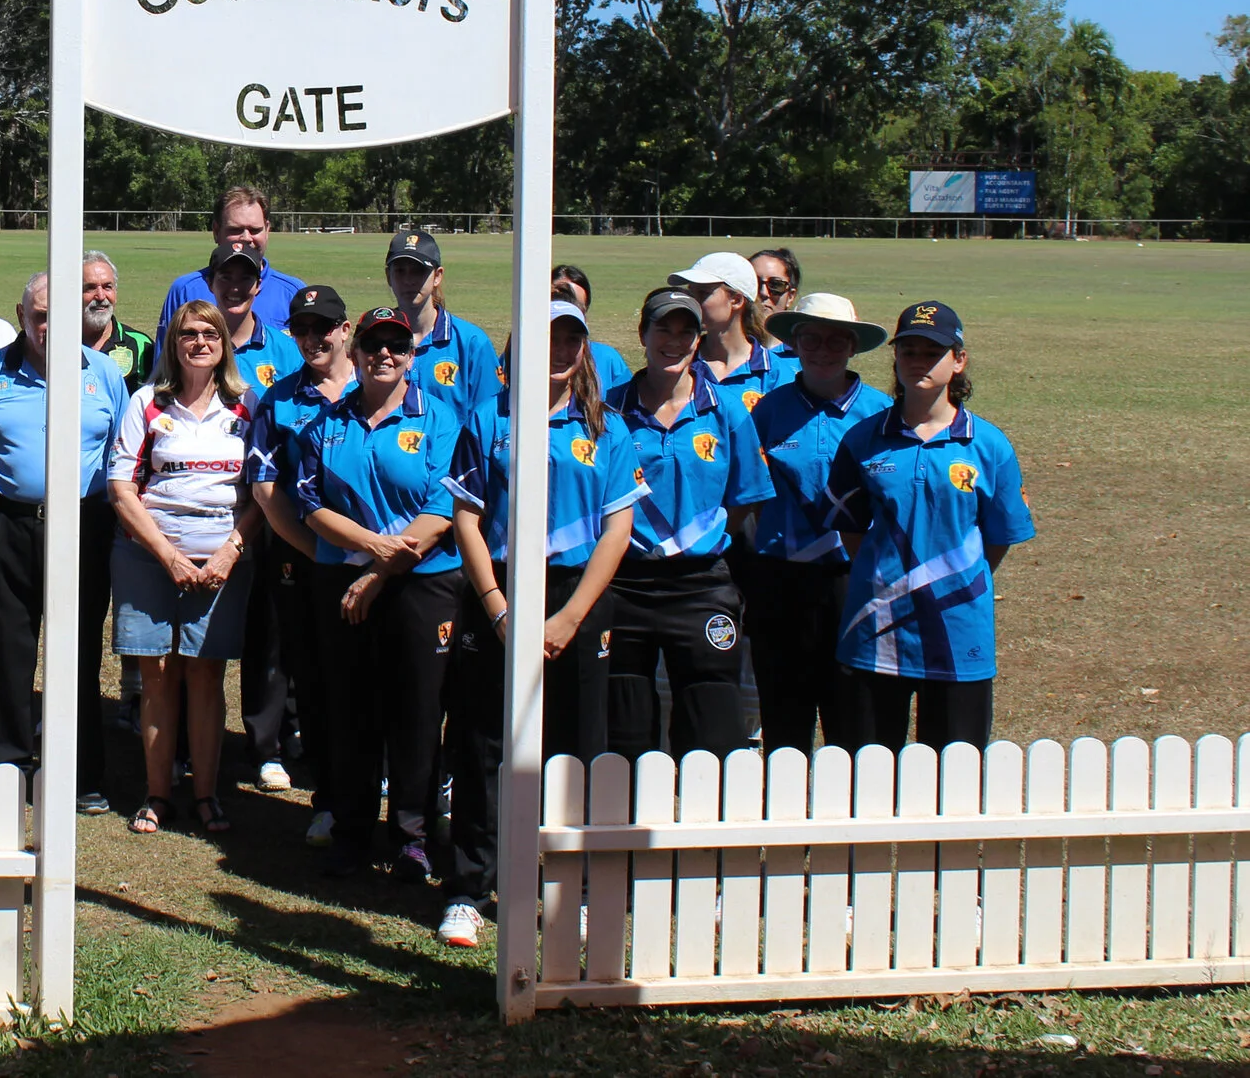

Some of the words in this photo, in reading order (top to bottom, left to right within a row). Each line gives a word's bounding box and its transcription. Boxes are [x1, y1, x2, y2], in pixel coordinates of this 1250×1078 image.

[236, 83, 367, 133] GATE
[923, 194, 963, 202] Gustafson
[160, 460, 242, 473] ALLTOOLS
